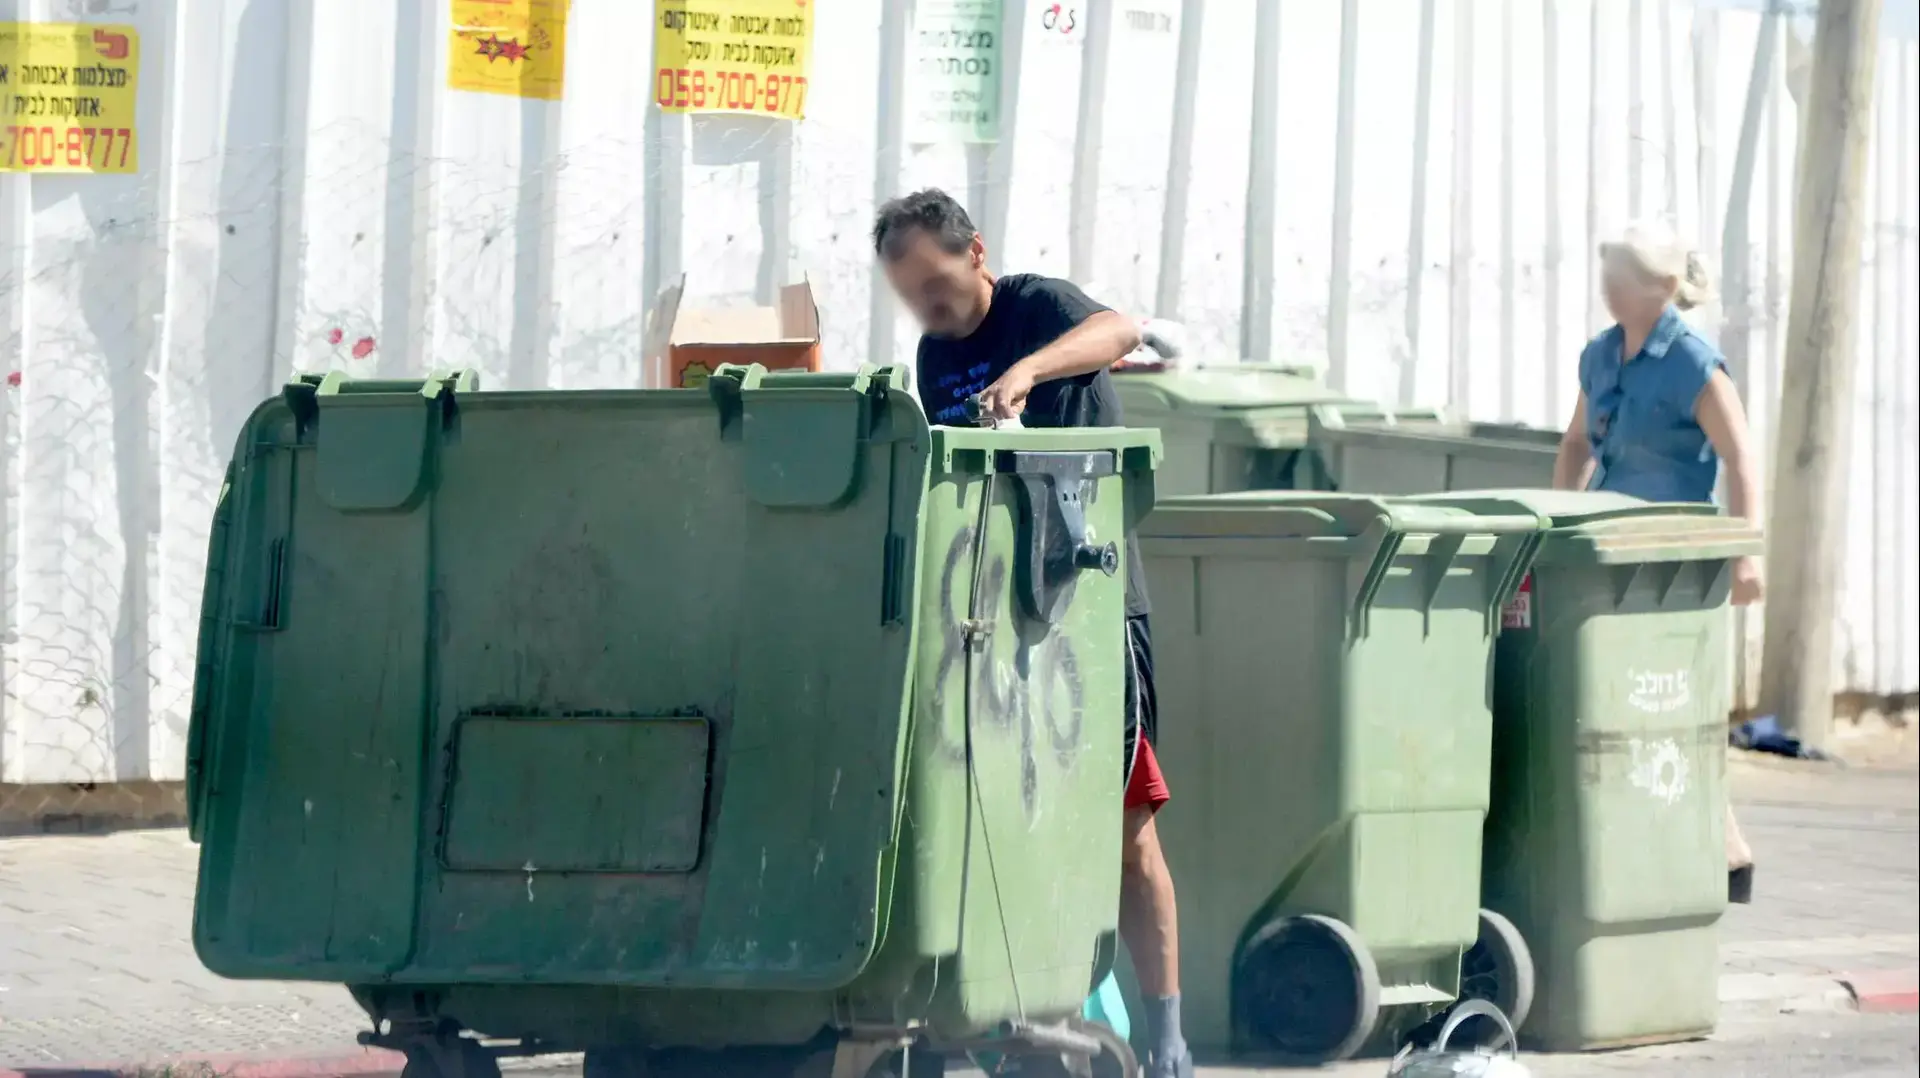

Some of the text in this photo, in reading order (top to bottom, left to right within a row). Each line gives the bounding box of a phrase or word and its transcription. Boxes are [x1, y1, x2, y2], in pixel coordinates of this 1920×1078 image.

[687, 40, 711, 62] עסק
[722, 40, 749, 62] לבית
[22, 64, 68, 86] אבטחה
[73, 62, 127, 87] מצלמות
[14, 91, 45, 115] לבית
[51, 97, 100, 122] אזעקות
